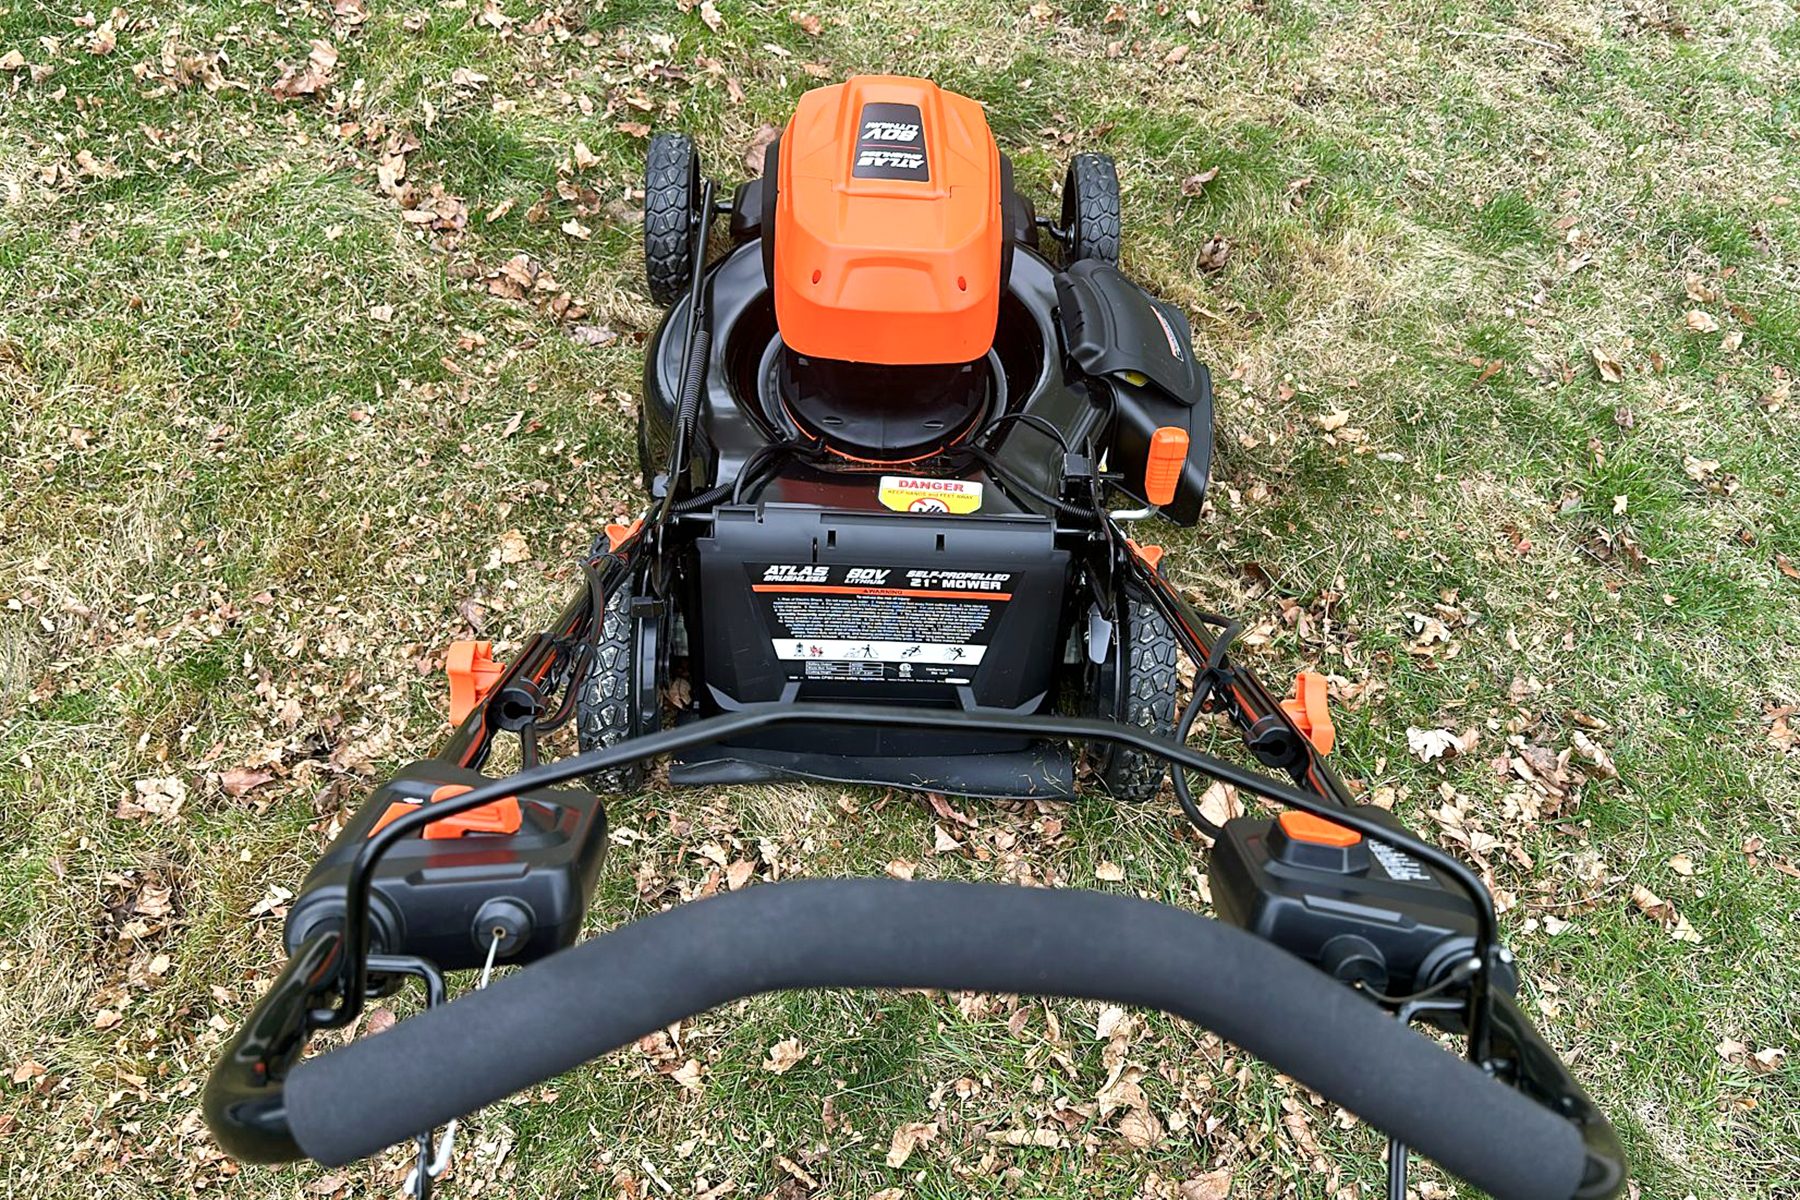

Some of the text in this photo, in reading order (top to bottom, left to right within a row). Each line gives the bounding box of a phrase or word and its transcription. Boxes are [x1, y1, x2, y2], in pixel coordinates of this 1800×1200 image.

[865, 122, 919, 131] LITHIUM
[862, 129, 918, 141] 80V
[857, 157, 925, 169] ATLAS
[898, 480, 964, 493] DANGER
[763, 565, 830, 576] ATLAS
[845, 568, 891, 579] 80V
[906, 570, 1011, 581] SELF-PROPELLED
[763, 575, 828, 583] BRUSHLESS
[910, 578, 1002, 590] 21" MOWER
